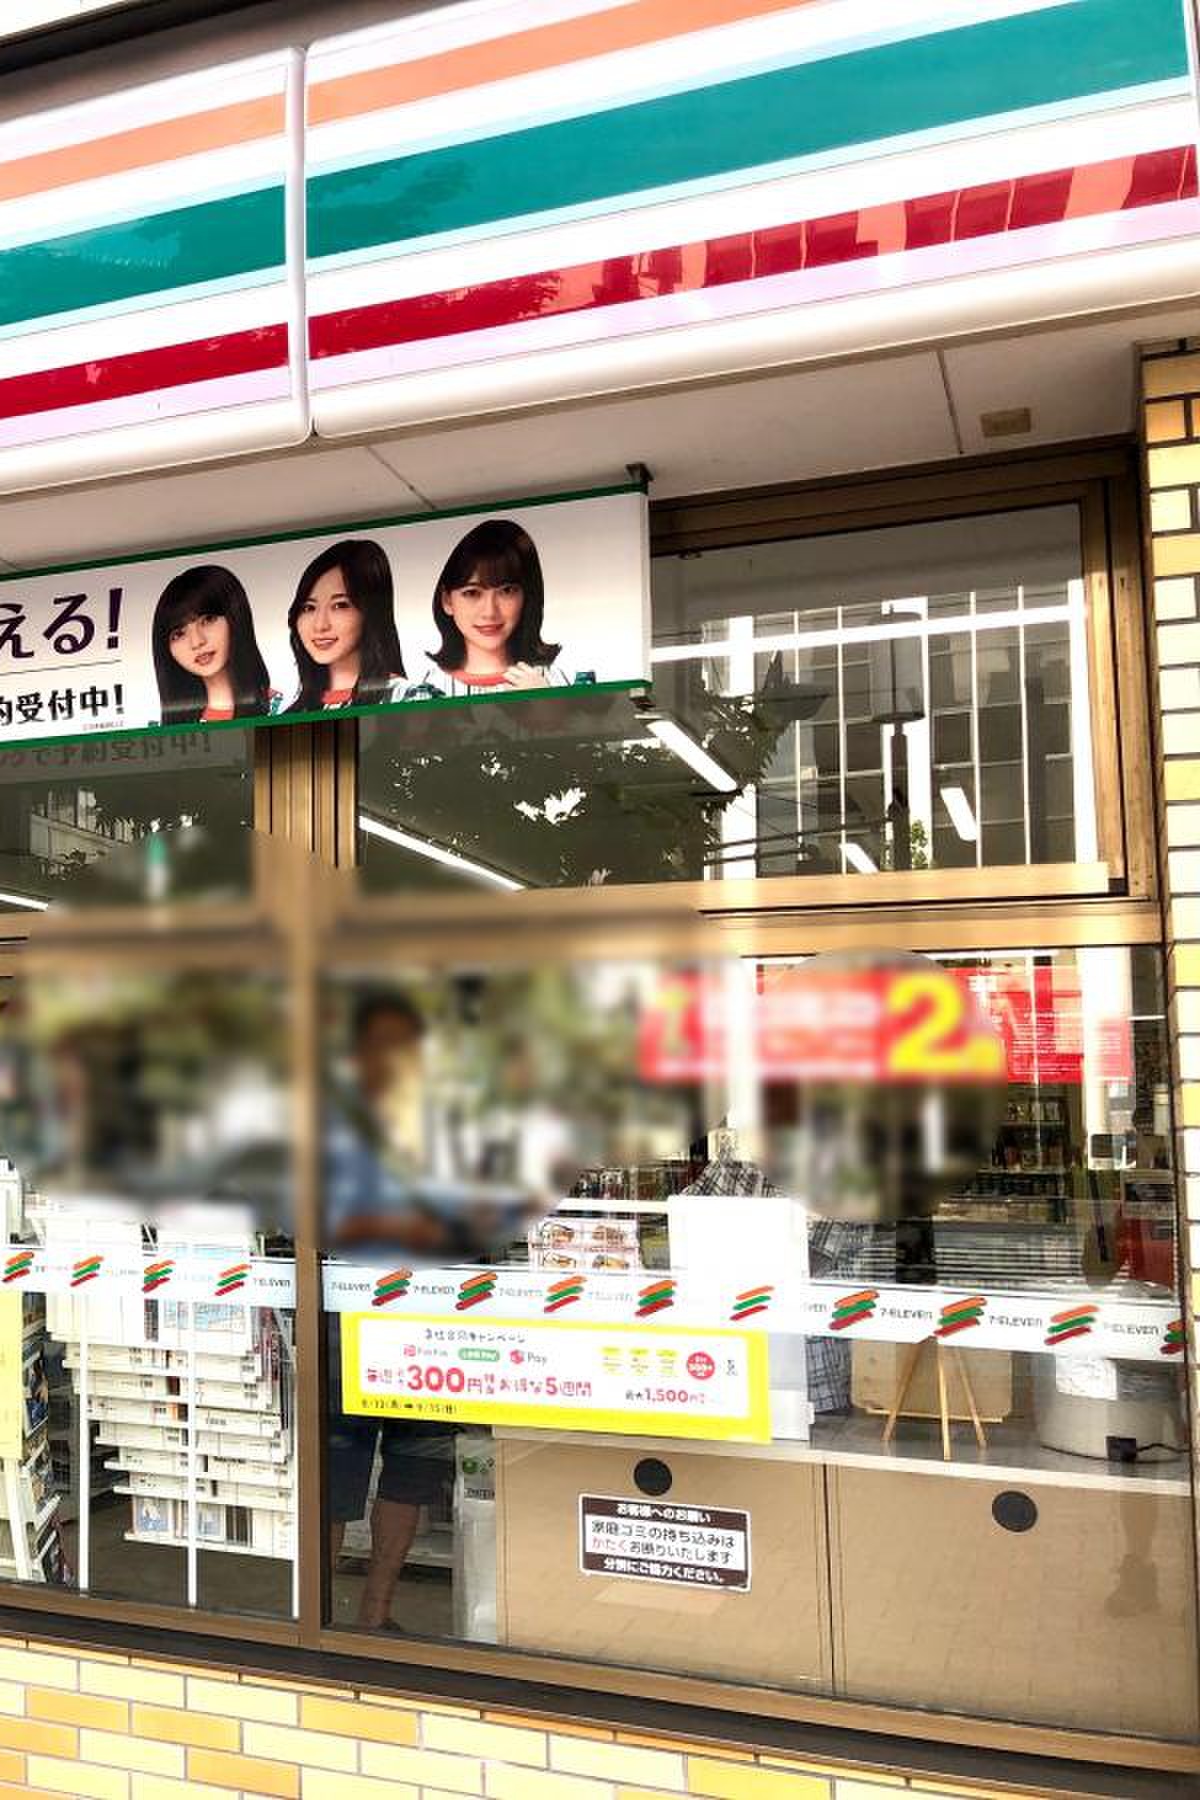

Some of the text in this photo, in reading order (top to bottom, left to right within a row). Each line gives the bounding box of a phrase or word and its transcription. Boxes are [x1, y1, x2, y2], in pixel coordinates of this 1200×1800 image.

[616, 1503, 711, 1523] お客様へのお願い
[591, 1520, 735, 1548] 家庭ゴミの持ち込みは
[591, 1537, 733, 1563] かたくお断りいたします
[603, 1558, 724, 1583] 分別にご協力ください。
